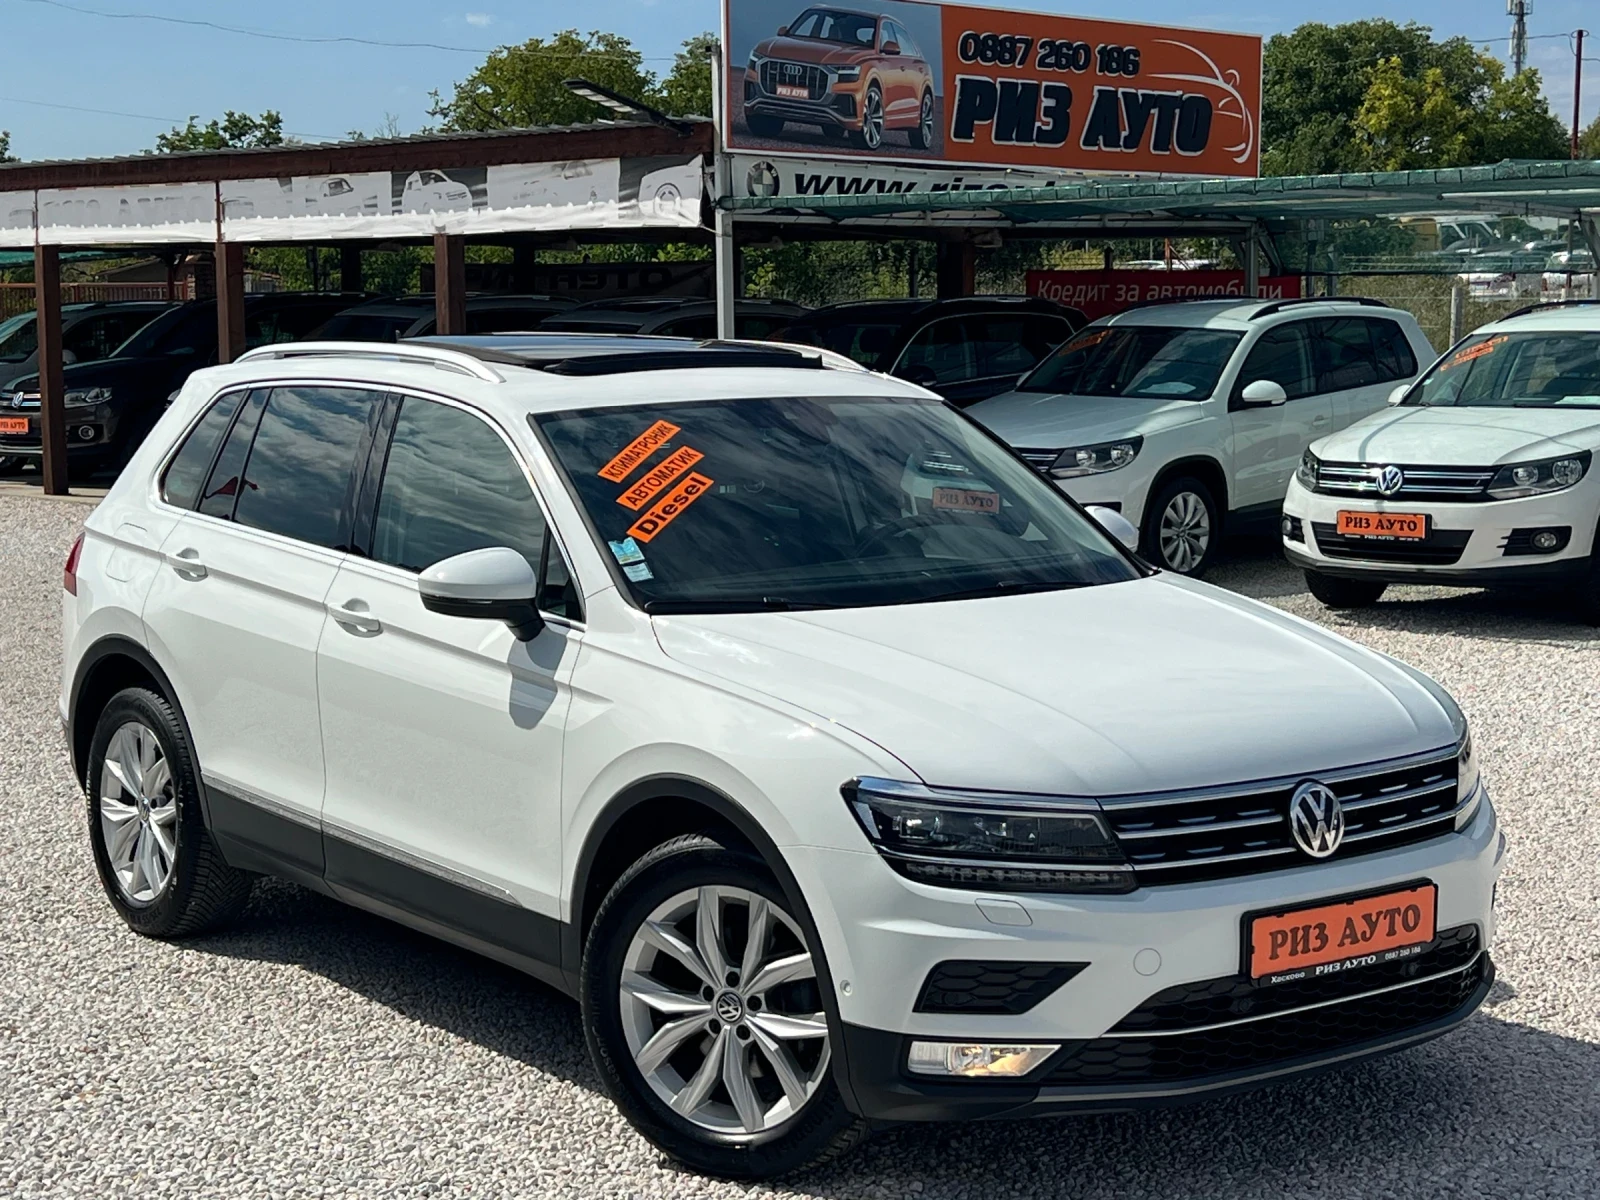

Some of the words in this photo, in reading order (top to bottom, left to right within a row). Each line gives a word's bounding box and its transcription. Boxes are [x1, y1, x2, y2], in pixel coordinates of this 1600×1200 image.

[959, 31, 1033, 68] 0887
[1036, 39, 1091, 73] 260
[1096, 43, 1141, 77] 186
[951, 74, 1073, 147] РИЗ
[1080, 86, 1213, 156] АУТО
[1037, 279, 1110, 306] Кредит
[1114, 284, 1140, 302] за
[604, 423, 673, 479] КЛИМАТРОНИК
[625, 449, 698, 507] АВТОМАТИК
[962, 495, 994, 508] АУТО
[636, 476, 707, 535] Diesel
[1345, 516, 1371, 529] РИЗ
[1375, 518, 1417, 532] АУТО
[1269, 922, 1329, 960] РИЗ
[1337, 904, 1421, 947] АУТО
[1315, 962, 1341, 975] РИЗ
[1342, 955, 1377, 970] АУТО
